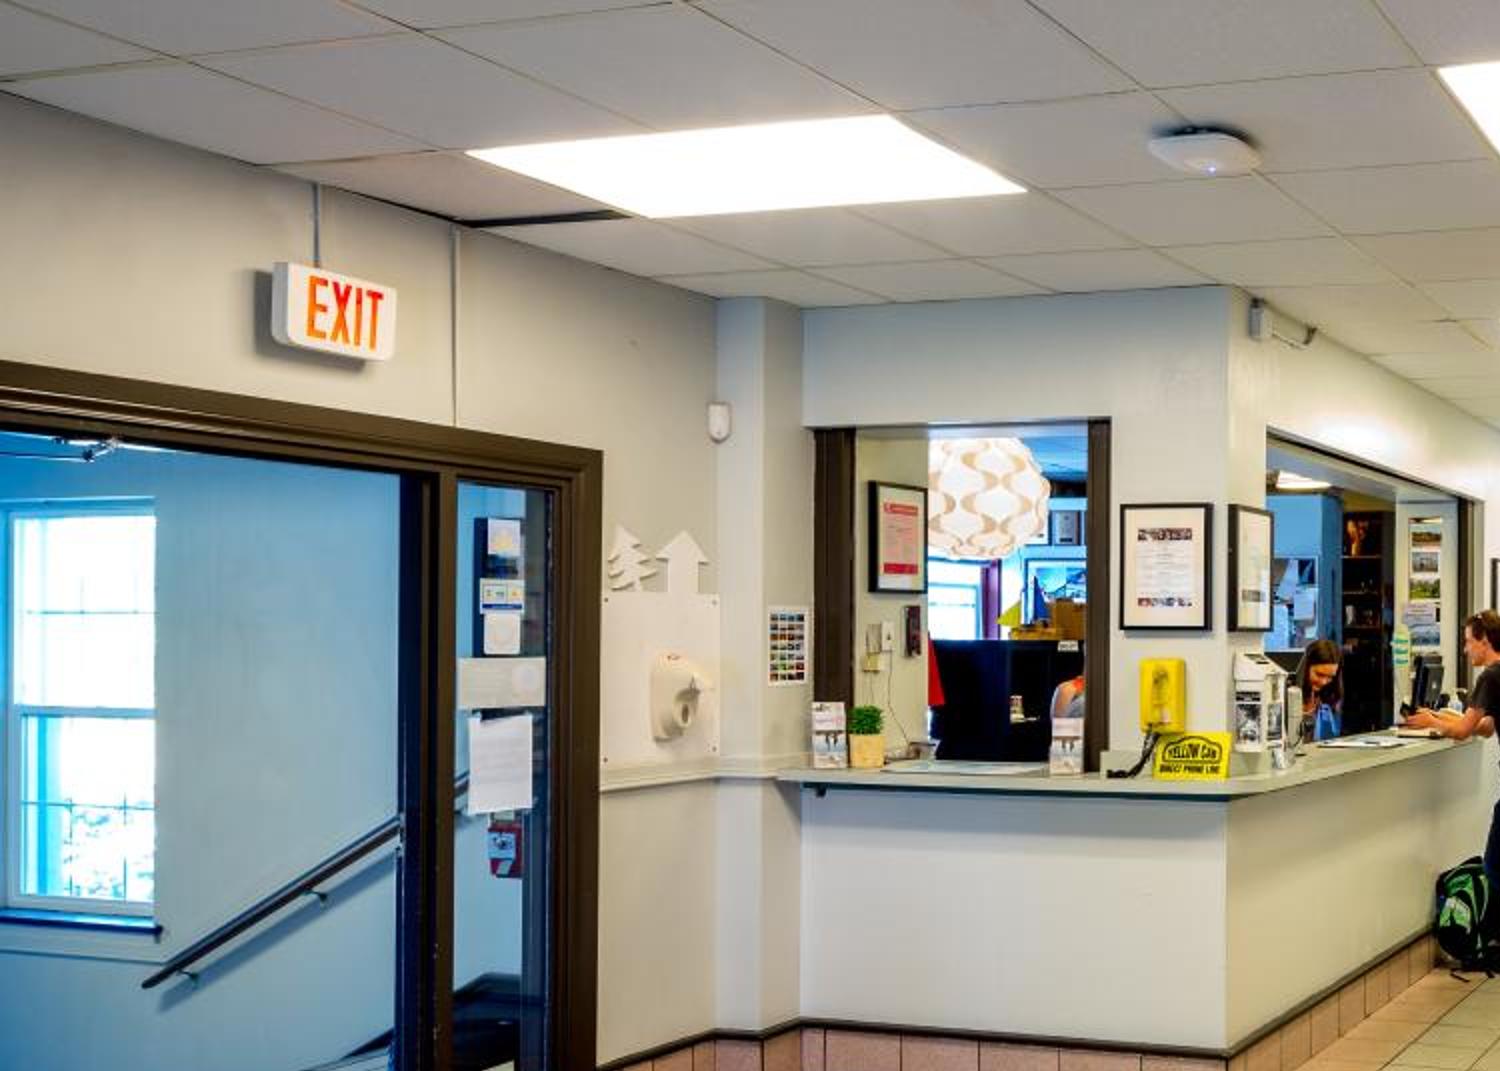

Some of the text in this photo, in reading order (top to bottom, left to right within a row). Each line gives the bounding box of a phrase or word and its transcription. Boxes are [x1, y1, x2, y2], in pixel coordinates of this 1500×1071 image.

[306, 274, 385, 352] EXIT
[1167, 743, 1217, 759] YELLOW CAB
